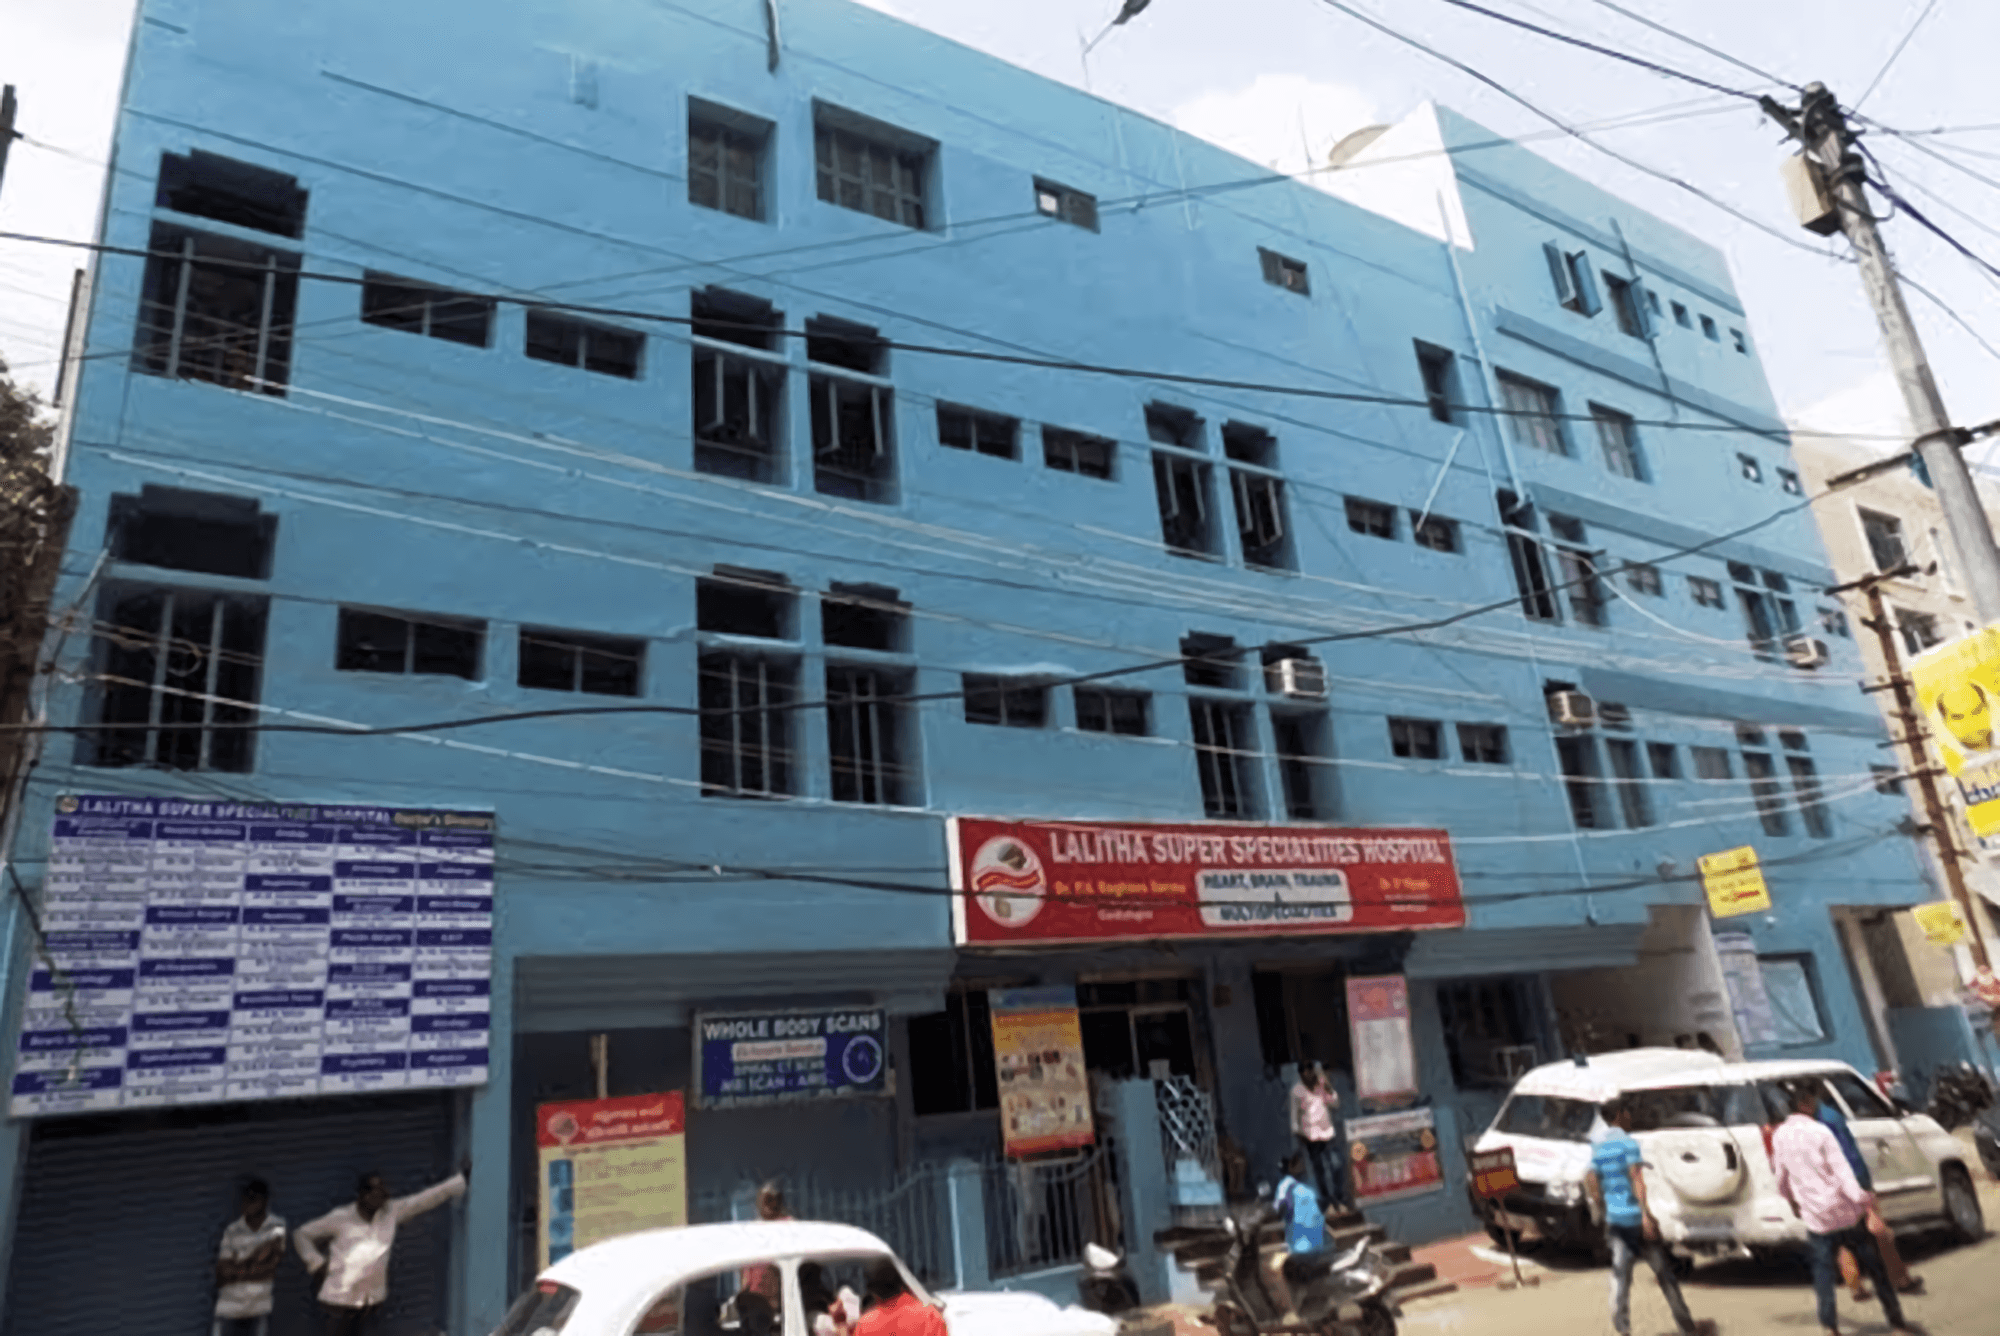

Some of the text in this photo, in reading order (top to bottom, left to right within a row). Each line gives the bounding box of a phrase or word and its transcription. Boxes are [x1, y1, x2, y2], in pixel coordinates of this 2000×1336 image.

[82, 799, 154, 814] LALITHA
[159, 802, 212, 817] SUPER
[1050, 831, 1446, 865] LALITHA SUPER SPECIALITIES HOSPITAL
[704, 1013, 881, 1040] WHOLE BODY SCANS
